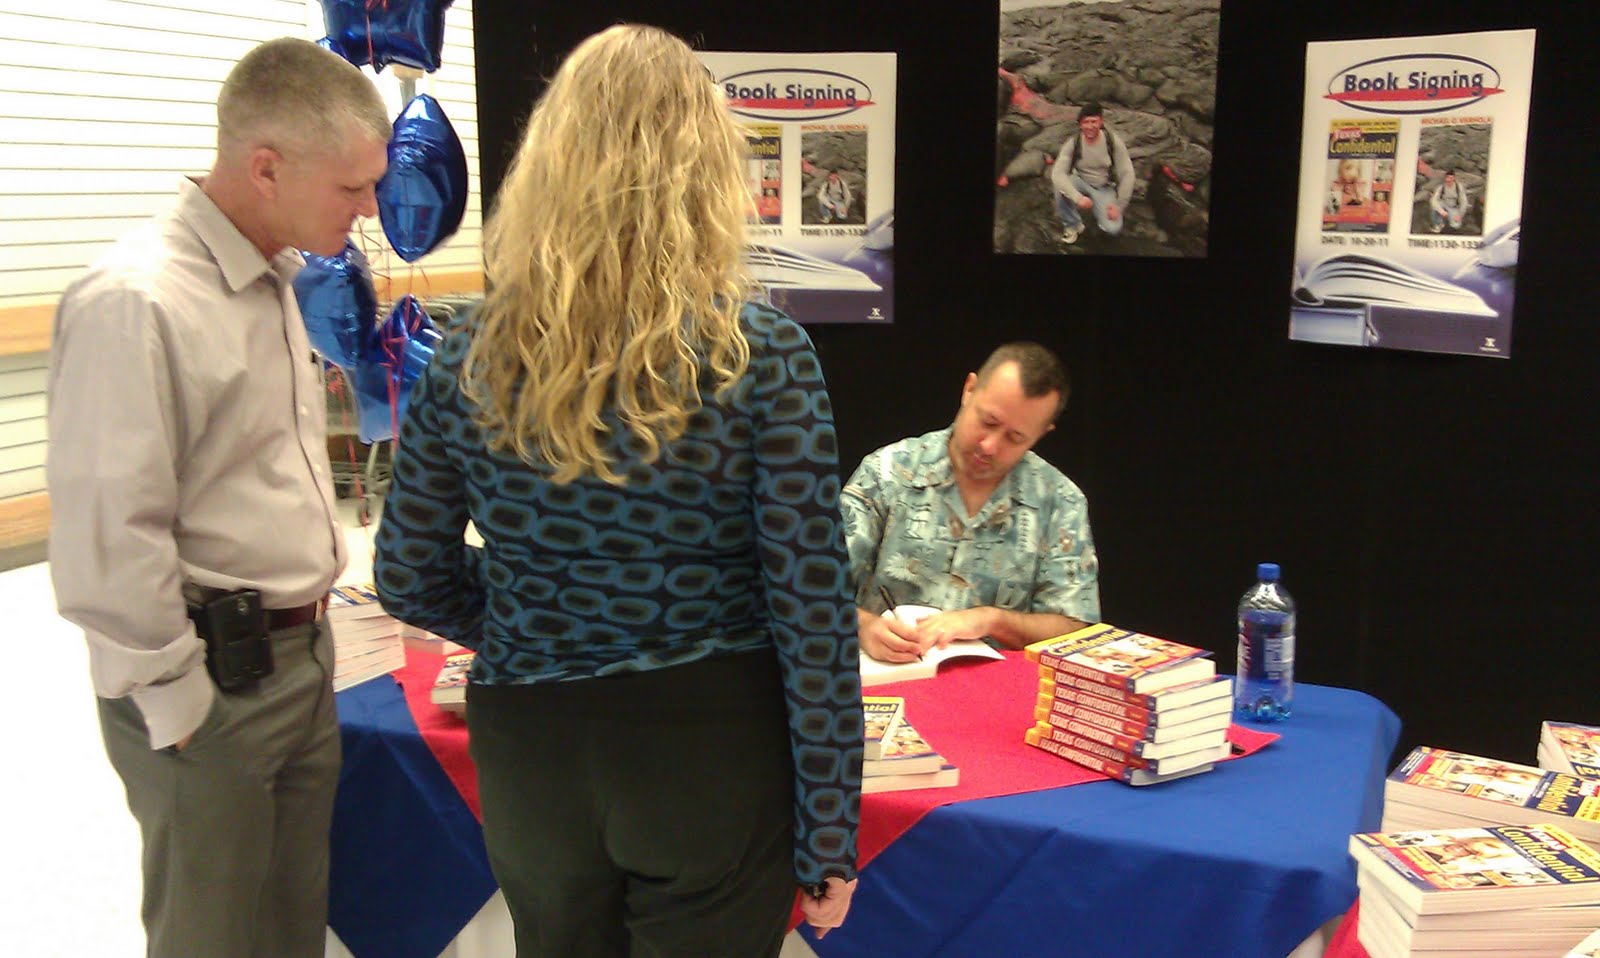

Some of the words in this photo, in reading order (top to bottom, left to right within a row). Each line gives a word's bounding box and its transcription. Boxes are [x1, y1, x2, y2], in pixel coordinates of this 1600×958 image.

[726, 83, 777, 99] Book
[785, 84, 857, 107] Signing
[1344, 72, 1399, 92] Book
[1408, 70, 1484, 98] Signing
[1329, 136, 1396, 153] Confidential
[1322, 236, 1347, 245] DATE:
[1040, 654, 1060, 668] TEXAS
[1060, 660, 1106, 683] CONFIDENTIAL
[1055, 671, 1077, 686] TEXAS
[1076, 678, 1125, 700] CONFIDENTIAL
[1053, 701, 1075, 716] TEXAS
[1074, 708, 1124, 731] CONFIDENTIAL
[1055, 687, 1078, 701] TEXAS
[1077, 694, 1127, 716] CONFIDENTIAL
[1049, 714, 1070, 728] TEXAS
[1068, 721, 1115, 745] CONFIDENTIAL
[1040, 739, 1060, 753] TEXAS
[1058, 746, 1104, 771] CONFIDENTIAL
[1052, 730, 1075, 745] TEXAS
[1074, 737, 1125, 762] CONFIDENTIAL
[1497, 826, 1600, 882] Confidential
